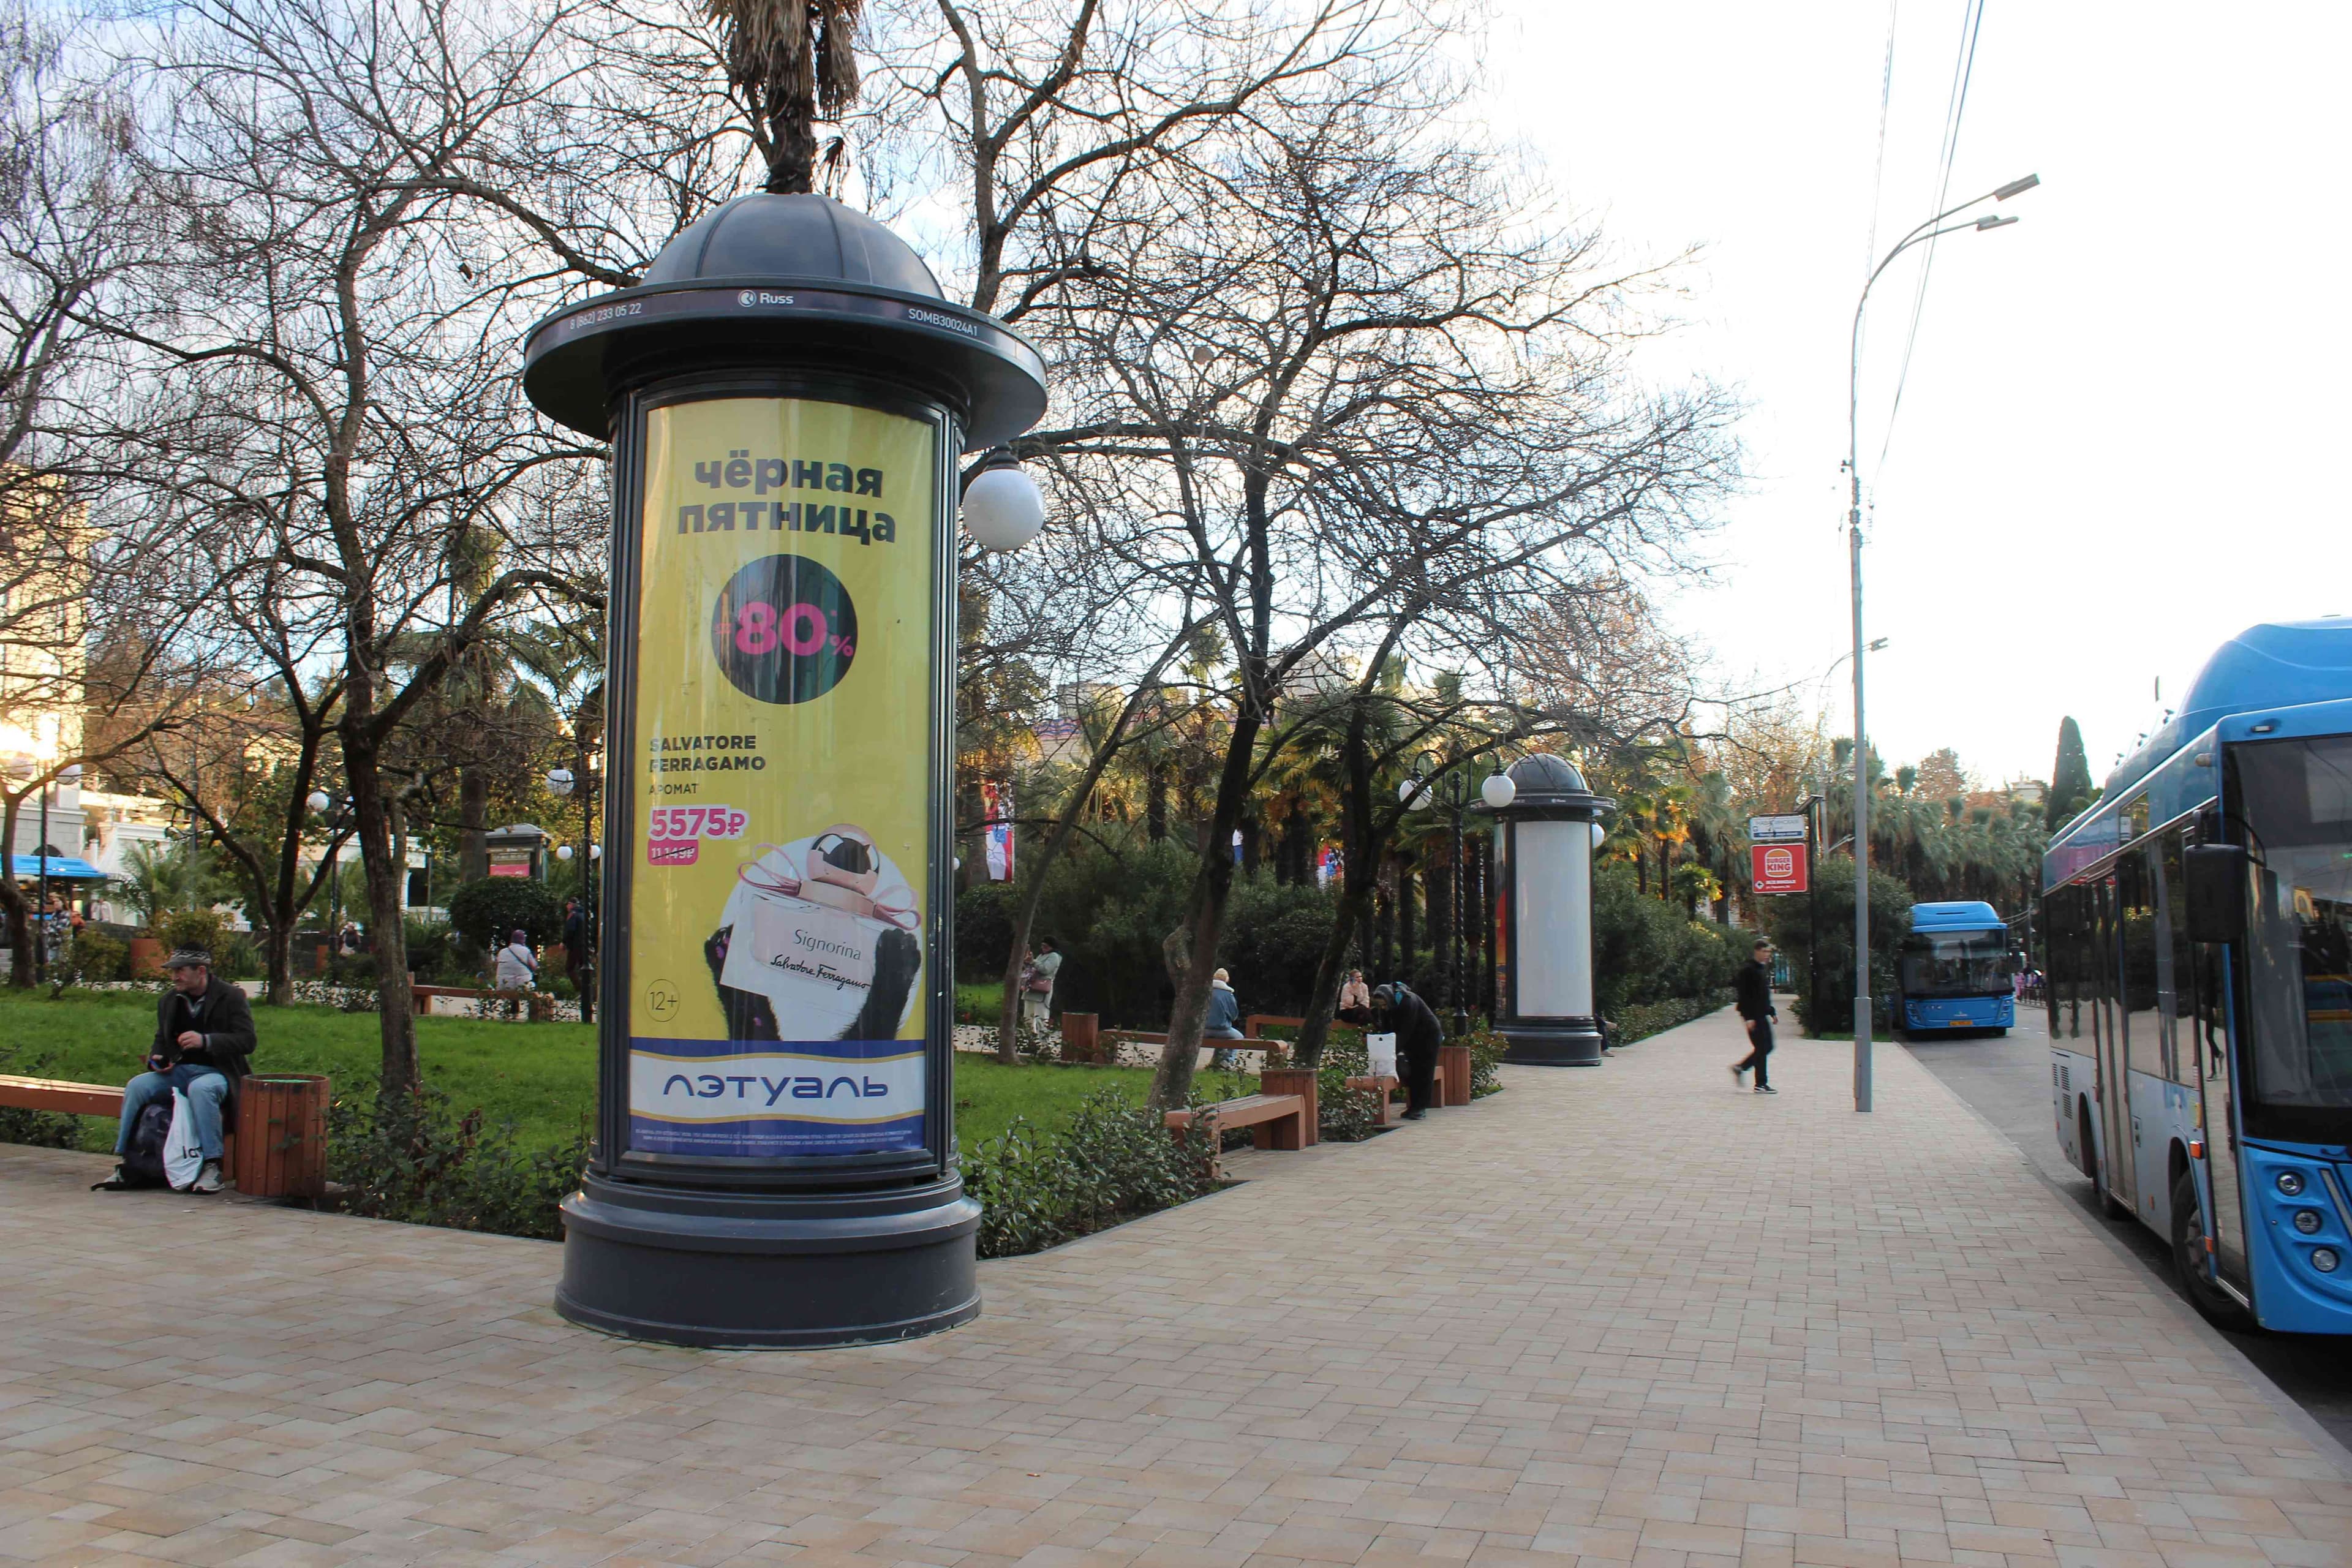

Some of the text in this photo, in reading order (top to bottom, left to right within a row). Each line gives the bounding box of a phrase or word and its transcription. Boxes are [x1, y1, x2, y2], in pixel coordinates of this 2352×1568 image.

[760, 292, 794, 304] Russ
[570, 318, 575, 330] 8
[597, 307, 613, 322] 233
[615, 305, 627, 317] 05
[628, 303, 642, 315] 22
[695, 450, 883, 499] чёрная
[677, 502, 896, 546] пятница
[649, 735, 756, 752] SALVATORE
[649, 756, 766, 773] FERRAGAMO
[794, 929, 862, 961] Signorina
[771, 954, 871, 991] Salvatore Ferragamo
[650, 991, 677, 1010] 12+
